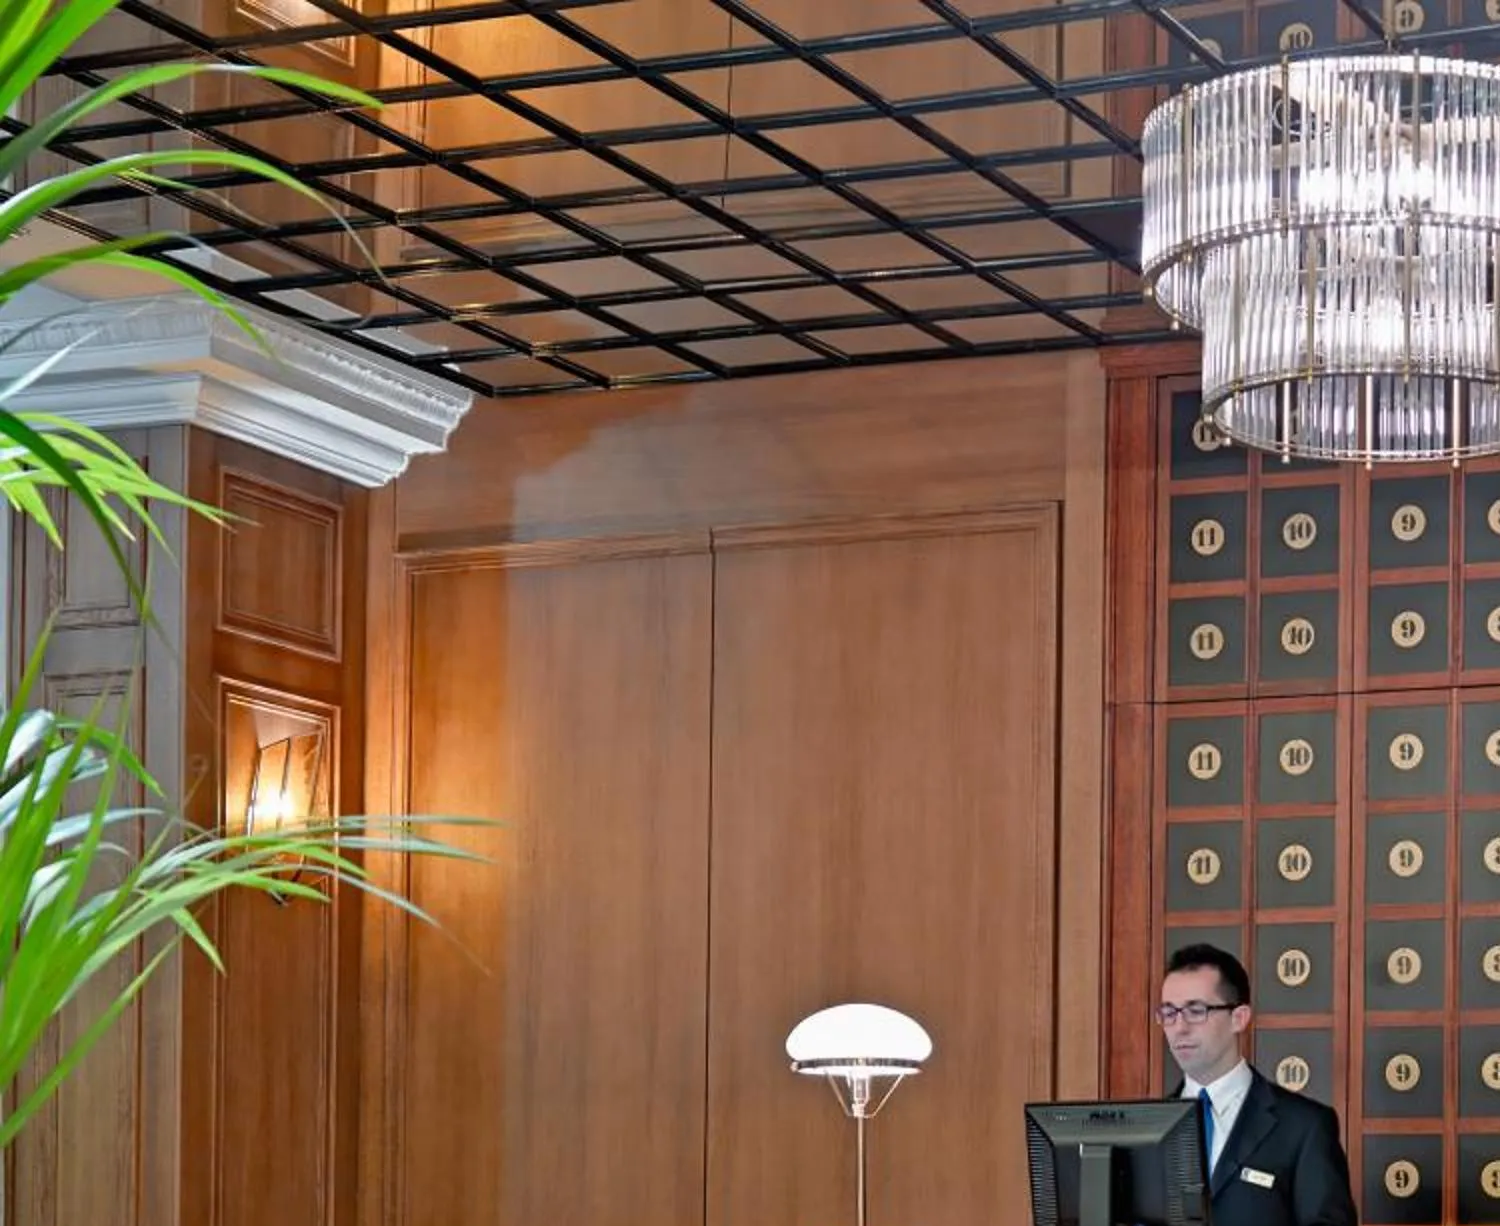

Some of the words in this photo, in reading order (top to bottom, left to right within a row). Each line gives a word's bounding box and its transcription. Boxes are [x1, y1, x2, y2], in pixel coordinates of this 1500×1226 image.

[1288, 521, 1313, 542] 10
[1401, 513, 1417, 532] 9
[1197, 527, 1216, 547] 11
[1287, 626, 1311, 646] 10
[1400, 619, 1417, 639] 9
[1196, 631, 1215, 651] 11
[1194, 751, 1214, 771] 11
[1285, 747, 1310, 767] 10
[1398, 741, 1415, 761] 9
[1193, 855, 1211, 876] 11
[1284, 853, 1308, 873] 10
[1399, 848, 1415, 869] 9
[1283, 957, 1306, 978] 10
[1396, 955, 1413, 976] 9
[1281, 1063, 1305, 1084] 10
[1395, 1063, 1411, 1083] 9
[1394, 1169, 1410, 1189] 9
